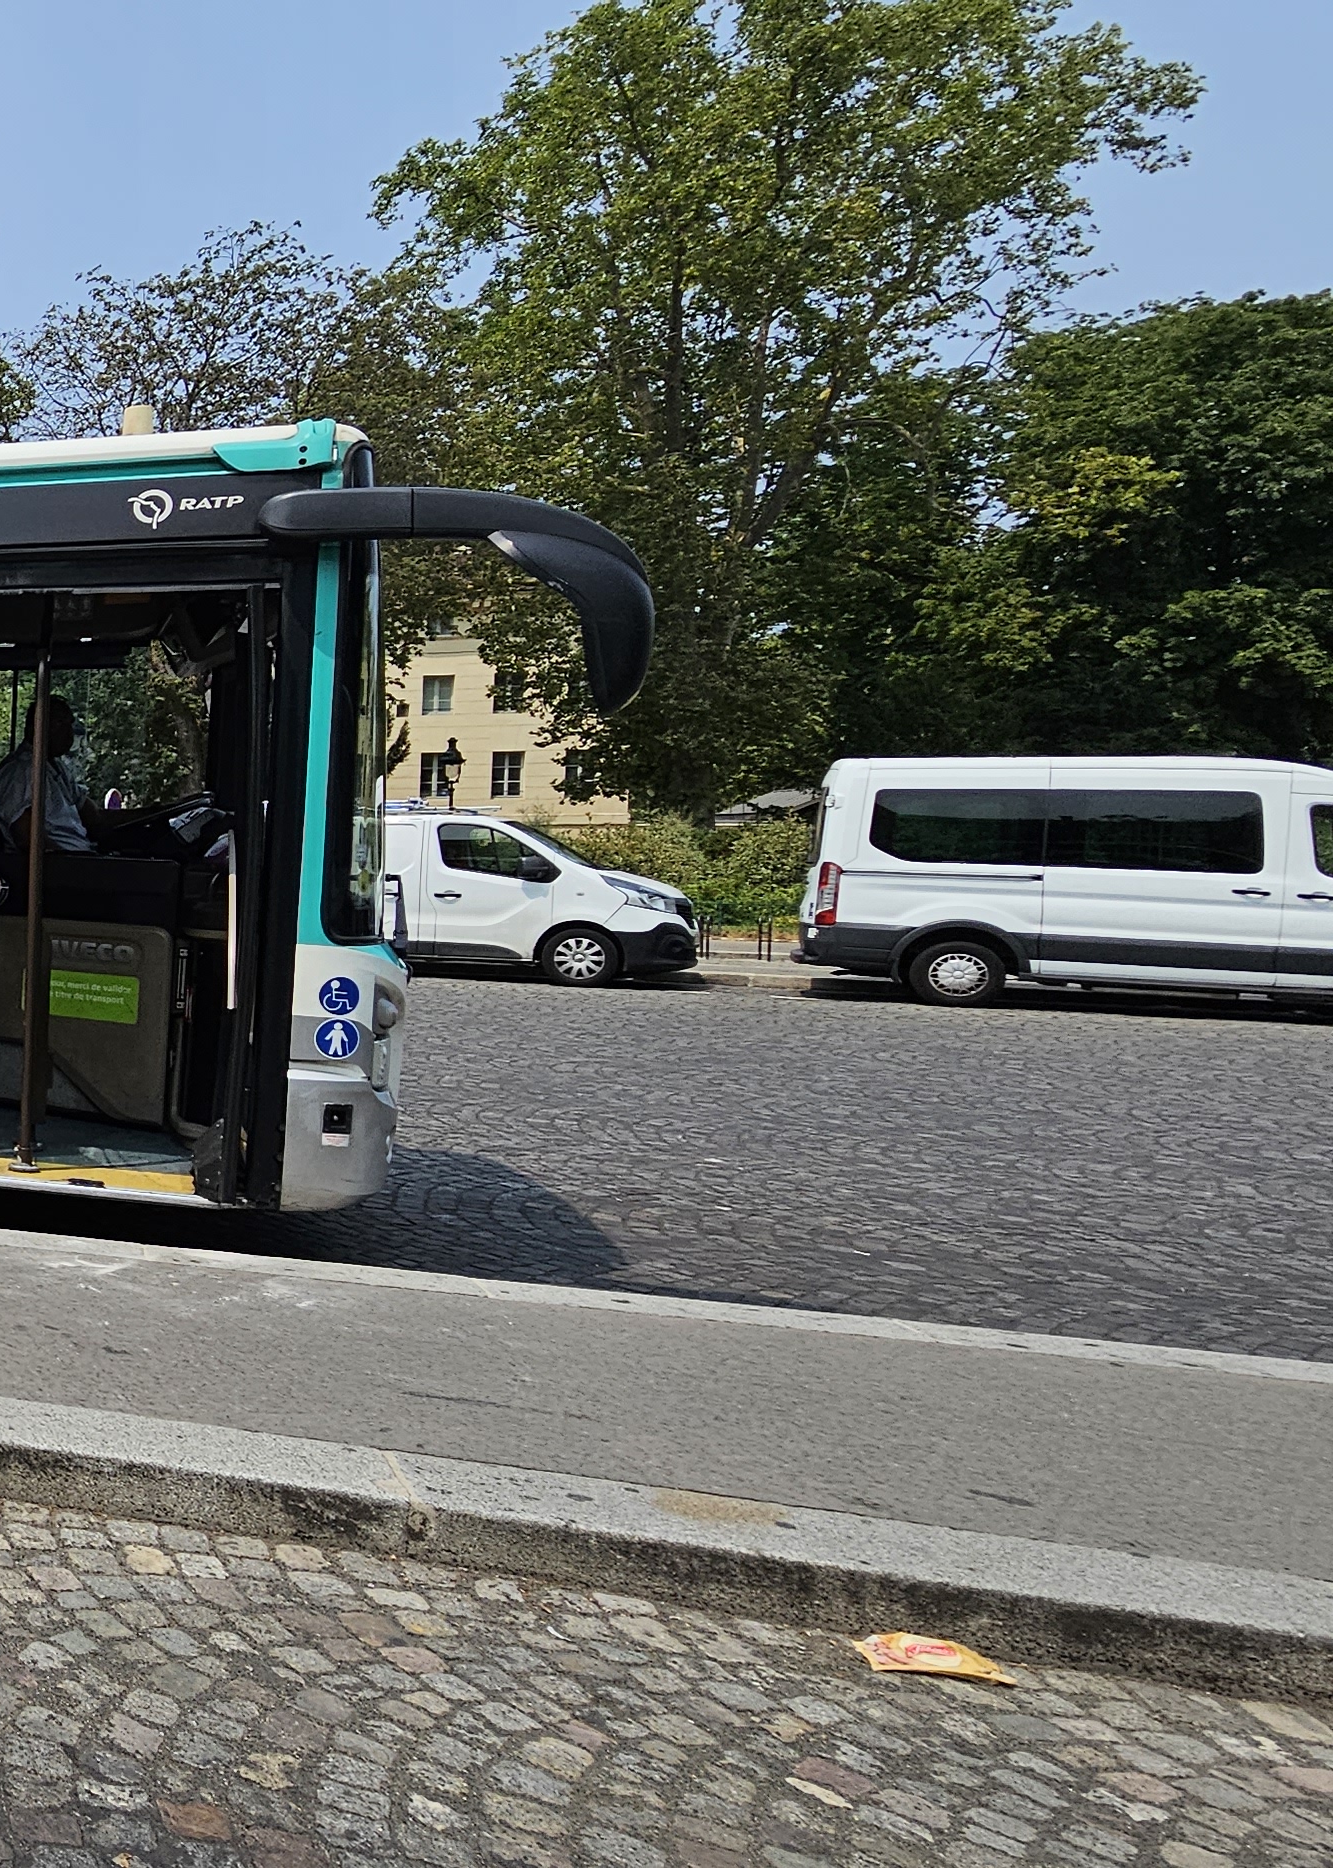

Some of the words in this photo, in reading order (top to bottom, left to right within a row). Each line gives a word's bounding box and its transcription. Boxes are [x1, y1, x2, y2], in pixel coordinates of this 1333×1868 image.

[179, 495, 245, 511] RATP
[51, 939, 135, 962] IVECO
[67, 982, 90, 991] merci
[103, 985, 133, 994] valider
[73, 992, 85, 1000] de
[86, 993, 125, 1004] transport
